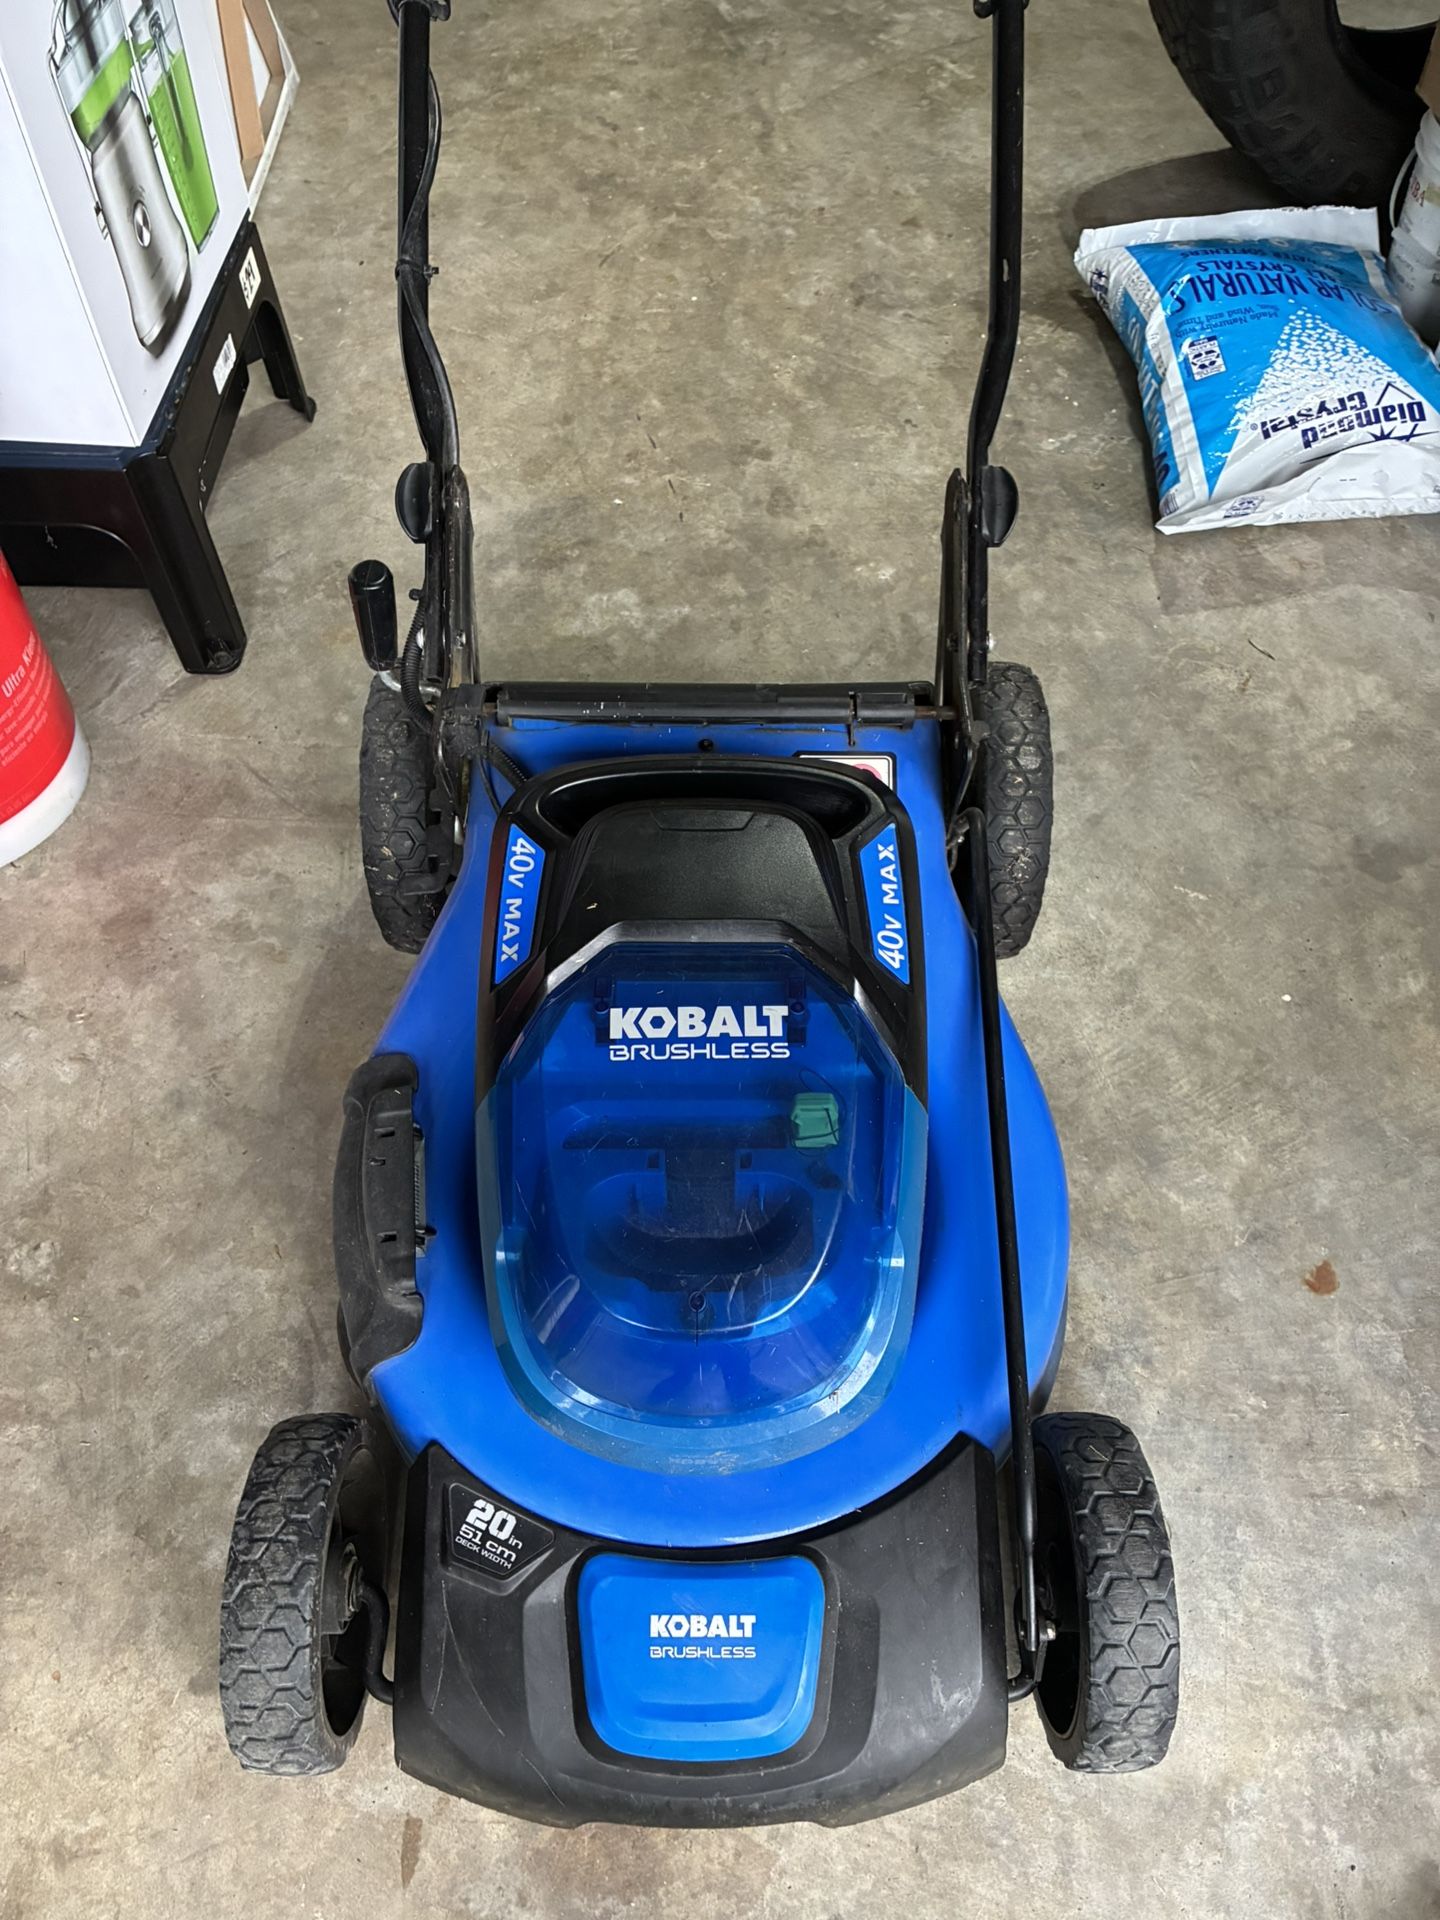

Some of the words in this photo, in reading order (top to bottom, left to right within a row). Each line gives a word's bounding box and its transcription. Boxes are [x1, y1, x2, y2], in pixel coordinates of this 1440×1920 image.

[1196, 260, 1296, 274] CRYSTALS
[1166, 272, 1308, 313] NATURALS
[1206, 313, 1224, 322] and
[1228, 306, 1254, 317] Wind
[1249, 311, 1278, 321] Made
[1260, 391, 1368, 440] Crystal
[1301, 401, 1427, 449] Diamond
[1, 664, 26, 698] Ultra
[877, 843, 900, 904] MAX
[500, 898, 523, 962] MAX
[609, 1005, 789, 1039] KOBALT
[609, 1042, 790, 1061] BRUSHLESS
[455, 1536, 480, 1554] DECK
[481, 1548, 513, 1570] WIDTH
[459, 1523, 483, 1545] 51
[485, 1540, 516, 1562] cm
[650, 1614, 757, 1638] KOBALT
[649, 1646, 757, 1659] BRUSHLESS
